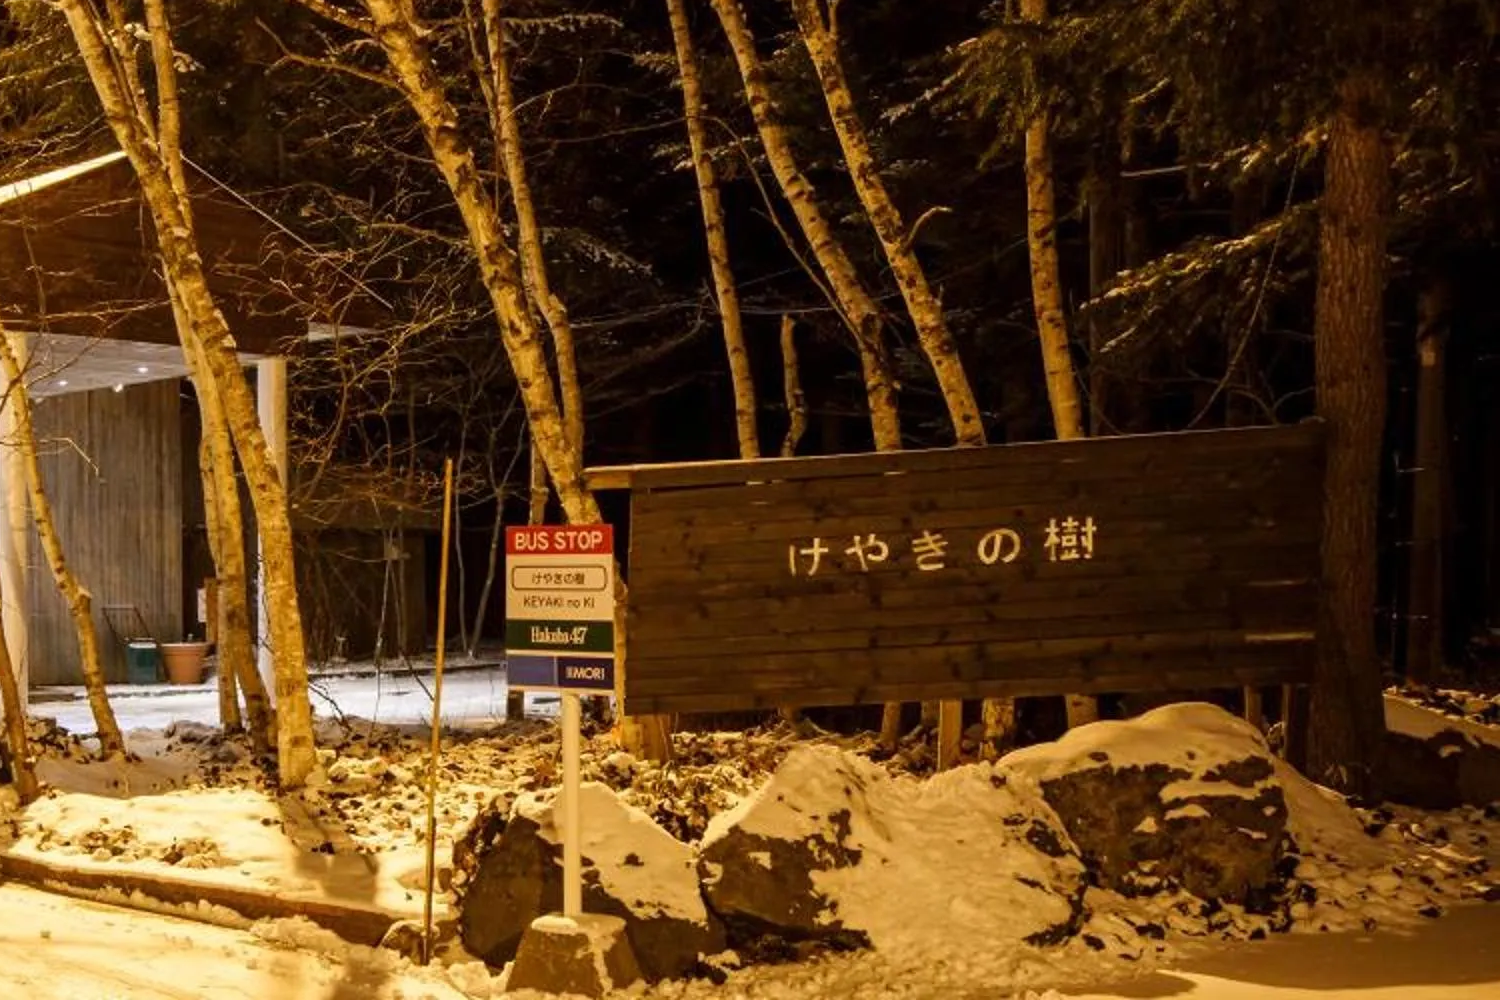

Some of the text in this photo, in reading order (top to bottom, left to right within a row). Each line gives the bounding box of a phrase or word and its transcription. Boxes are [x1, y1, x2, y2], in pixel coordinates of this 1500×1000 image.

[515, 531, 603, 551] BUS STOP
[788, 516, 1097, 577] けやきの樹
[523, 595, 595, 609] KEYAKI no KI
